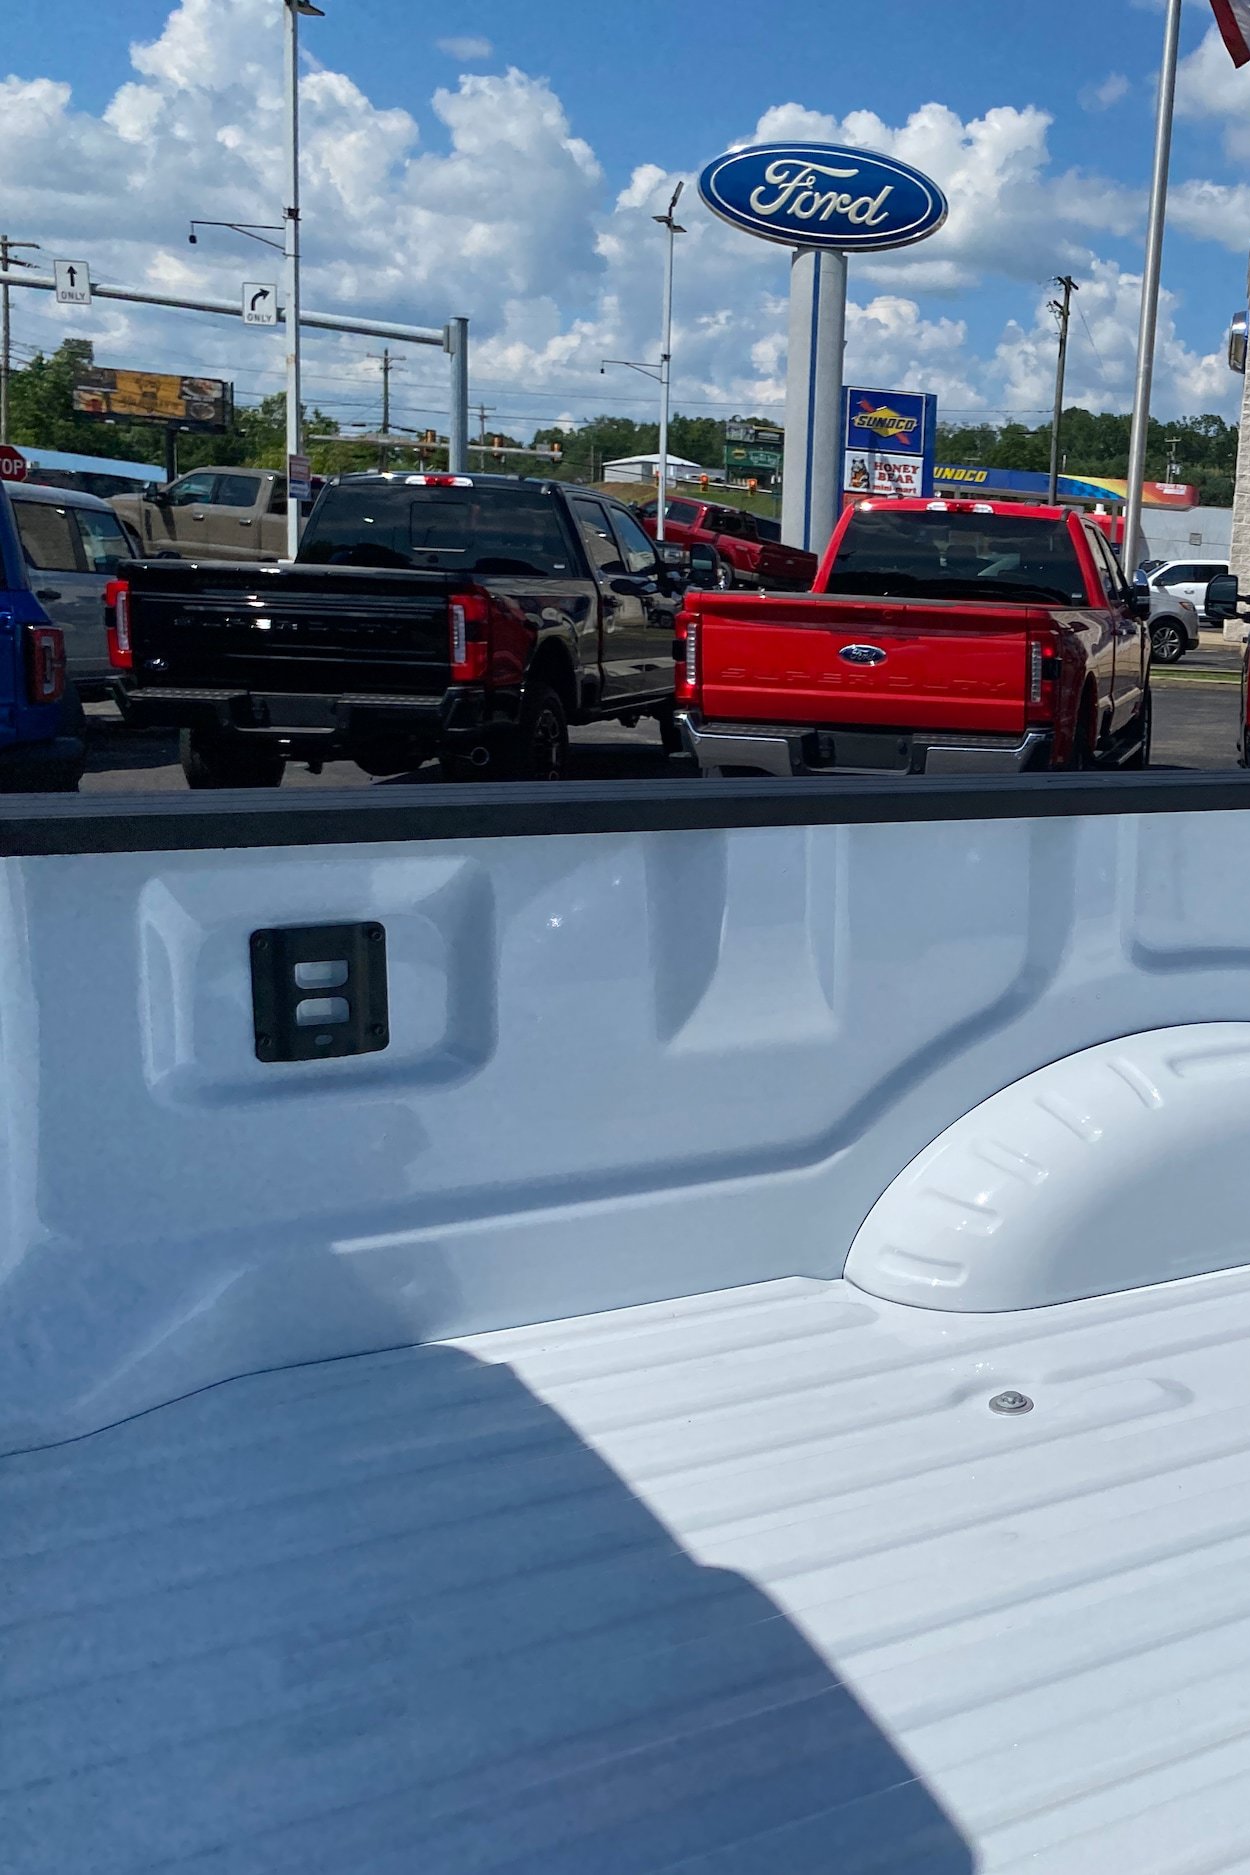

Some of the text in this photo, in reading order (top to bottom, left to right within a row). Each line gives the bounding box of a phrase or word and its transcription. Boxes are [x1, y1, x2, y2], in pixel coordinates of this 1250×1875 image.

[750, 159, 895, 227] Ford
[61, 291, 86, 301] ONLY
[247, 312, 272, 323] ONLY
[857, 415, 916, 431] SUNOCO
[0, 458, 24, 475] OP
[874, 461, 920, 474] HONEY
[878, 472, 914, 484] BEAR
[933, 466, 988, 483] UNOCO
